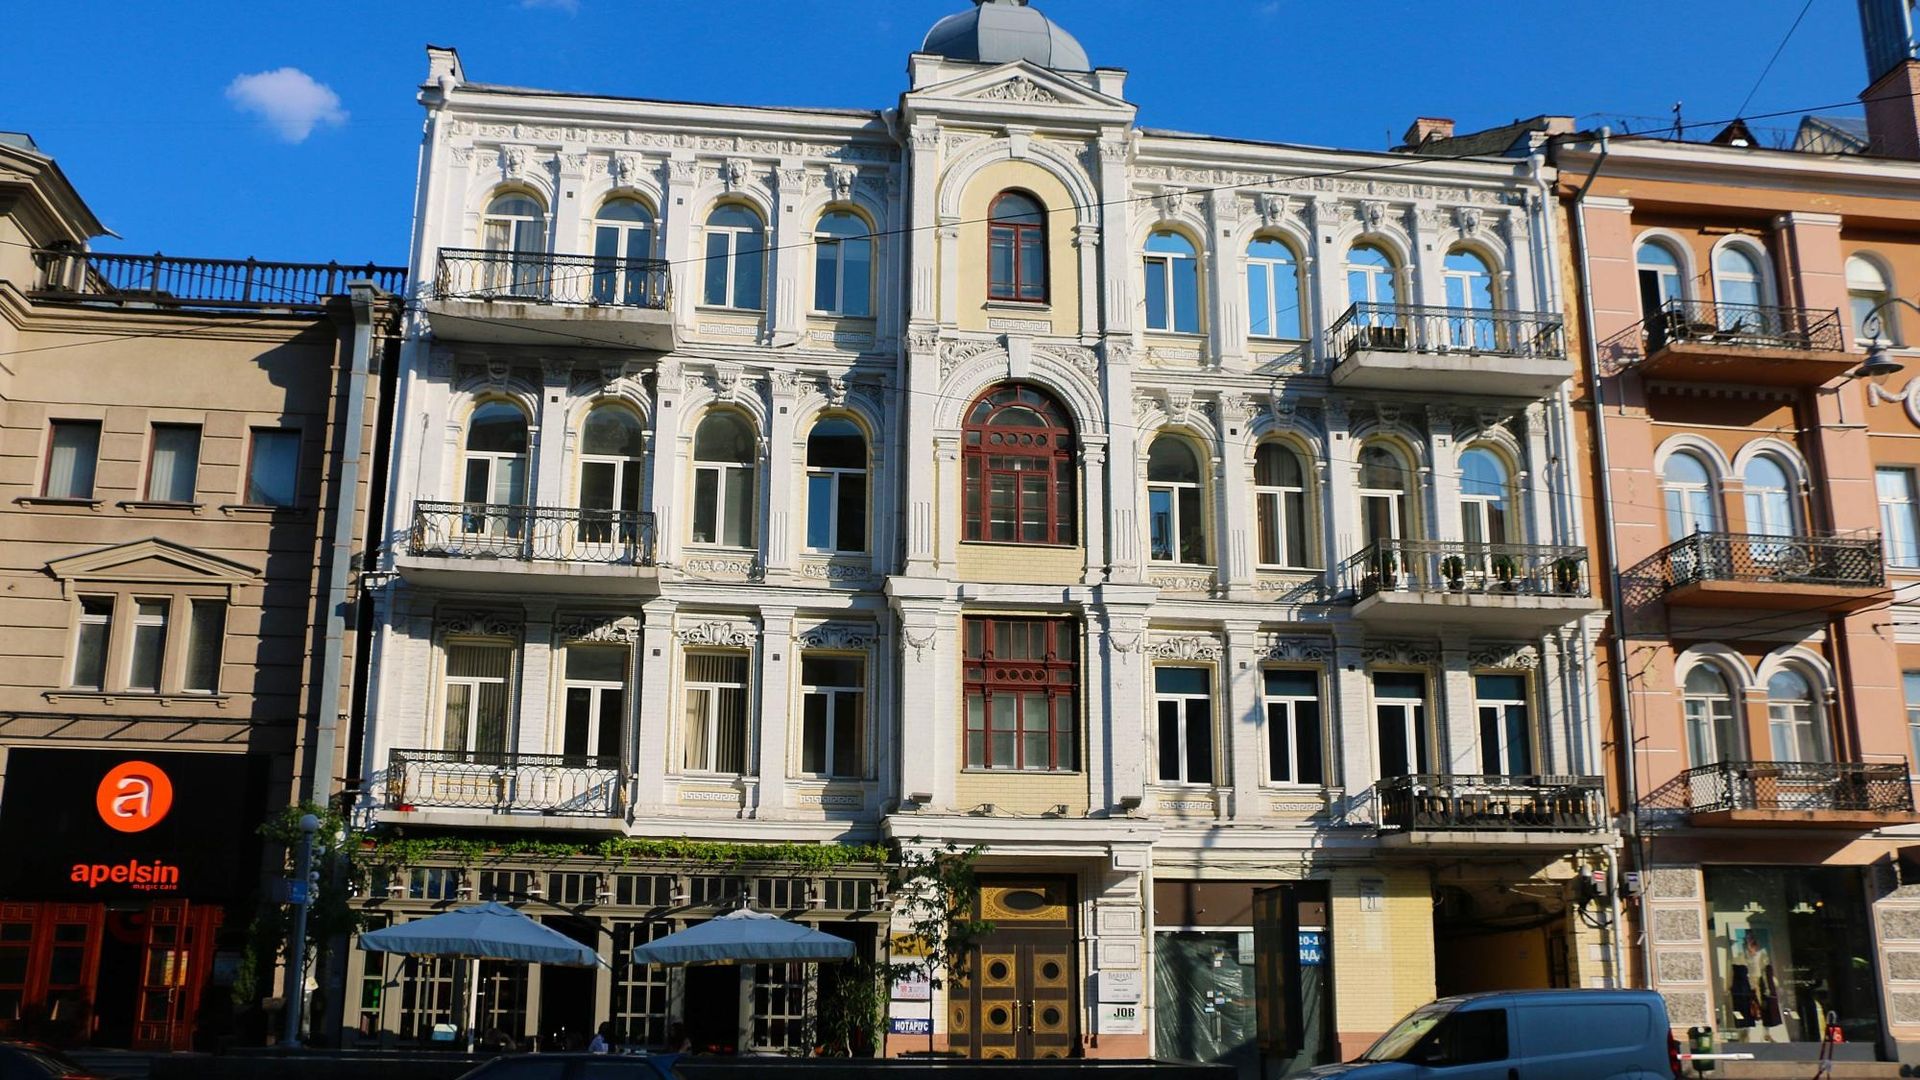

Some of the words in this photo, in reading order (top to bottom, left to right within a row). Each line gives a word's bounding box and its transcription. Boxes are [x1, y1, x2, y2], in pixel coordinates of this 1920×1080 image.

[112, 775, 152, 818] a
[71, 859, 179, 888] apelsin
[1113, 1007, 1135, 1018] JOB
